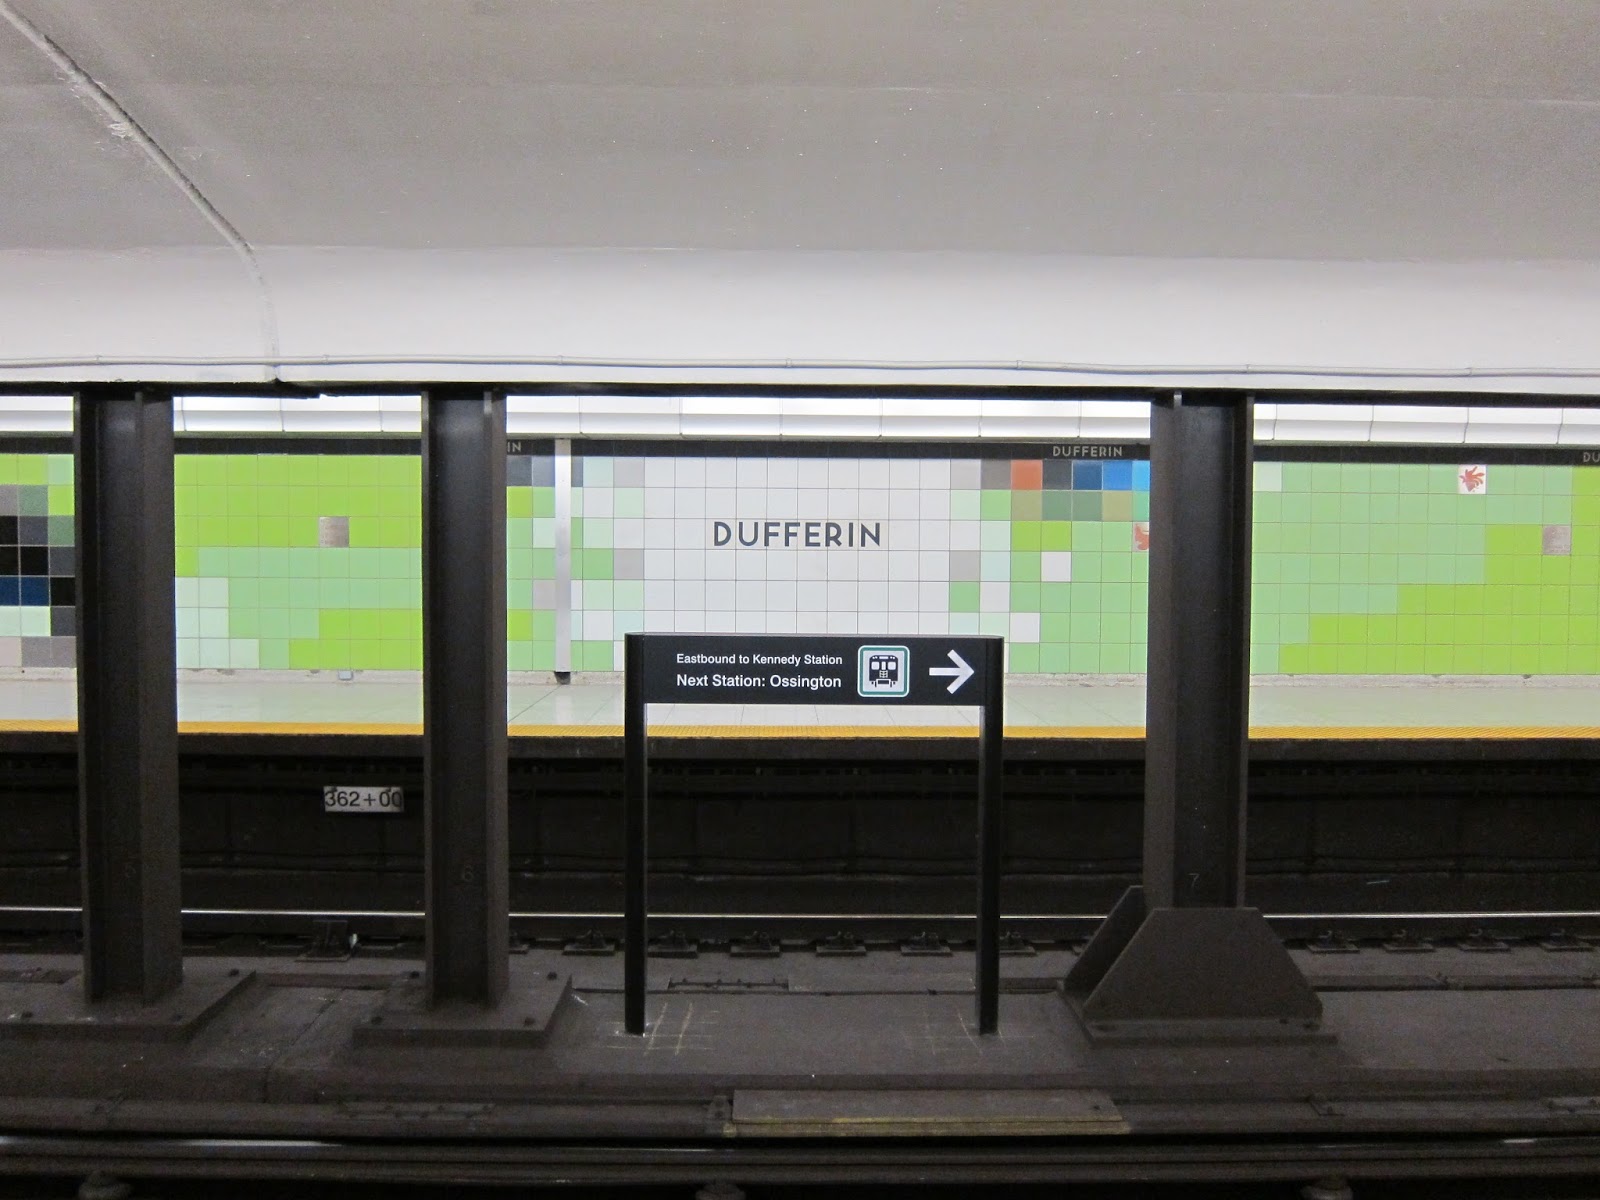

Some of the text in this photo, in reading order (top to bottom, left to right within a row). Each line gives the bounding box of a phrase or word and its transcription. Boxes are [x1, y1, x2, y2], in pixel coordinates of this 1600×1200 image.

[1052, 445, 1123, 458] DUFFERIN
[1583, 451, 1600, 463] DU
[713, 521, 880, 547] DUFFERIN
[676, 653, 843, 667] Eastbound to Kennedy Station
[676, 673, 842, 691] Next Station: Ossington
[325, 790, 402, 808] 362+00
[1188, 872, 1200, 889] 7
